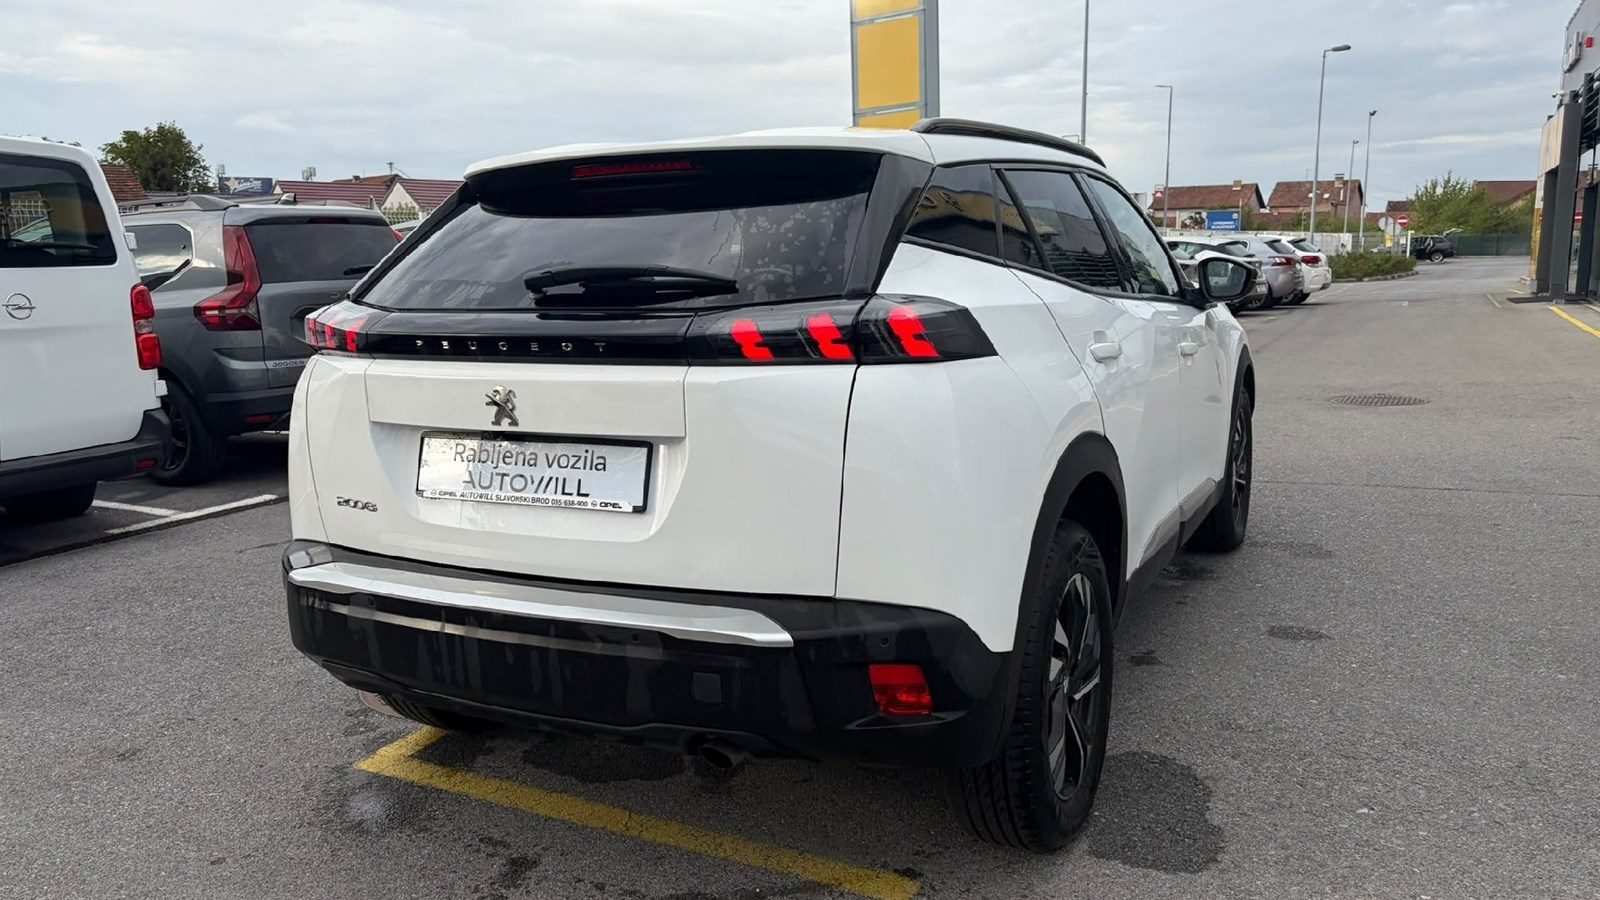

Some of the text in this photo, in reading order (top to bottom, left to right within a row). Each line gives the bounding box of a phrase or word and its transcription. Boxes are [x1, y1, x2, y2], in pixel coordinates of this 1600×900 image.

[415, 340, 606, 352] PEUGEOT
[453, 442, 607, 472] Rabljena vozila
[462, 470, 590, 497] AUTOWILL
[459, 491, 494, 501] AUTOWILL
[495, 494, 530, 503] SLAVONSKI
[531, 496, 549, 505] BROD
[551, 498, 562, 506] 035
